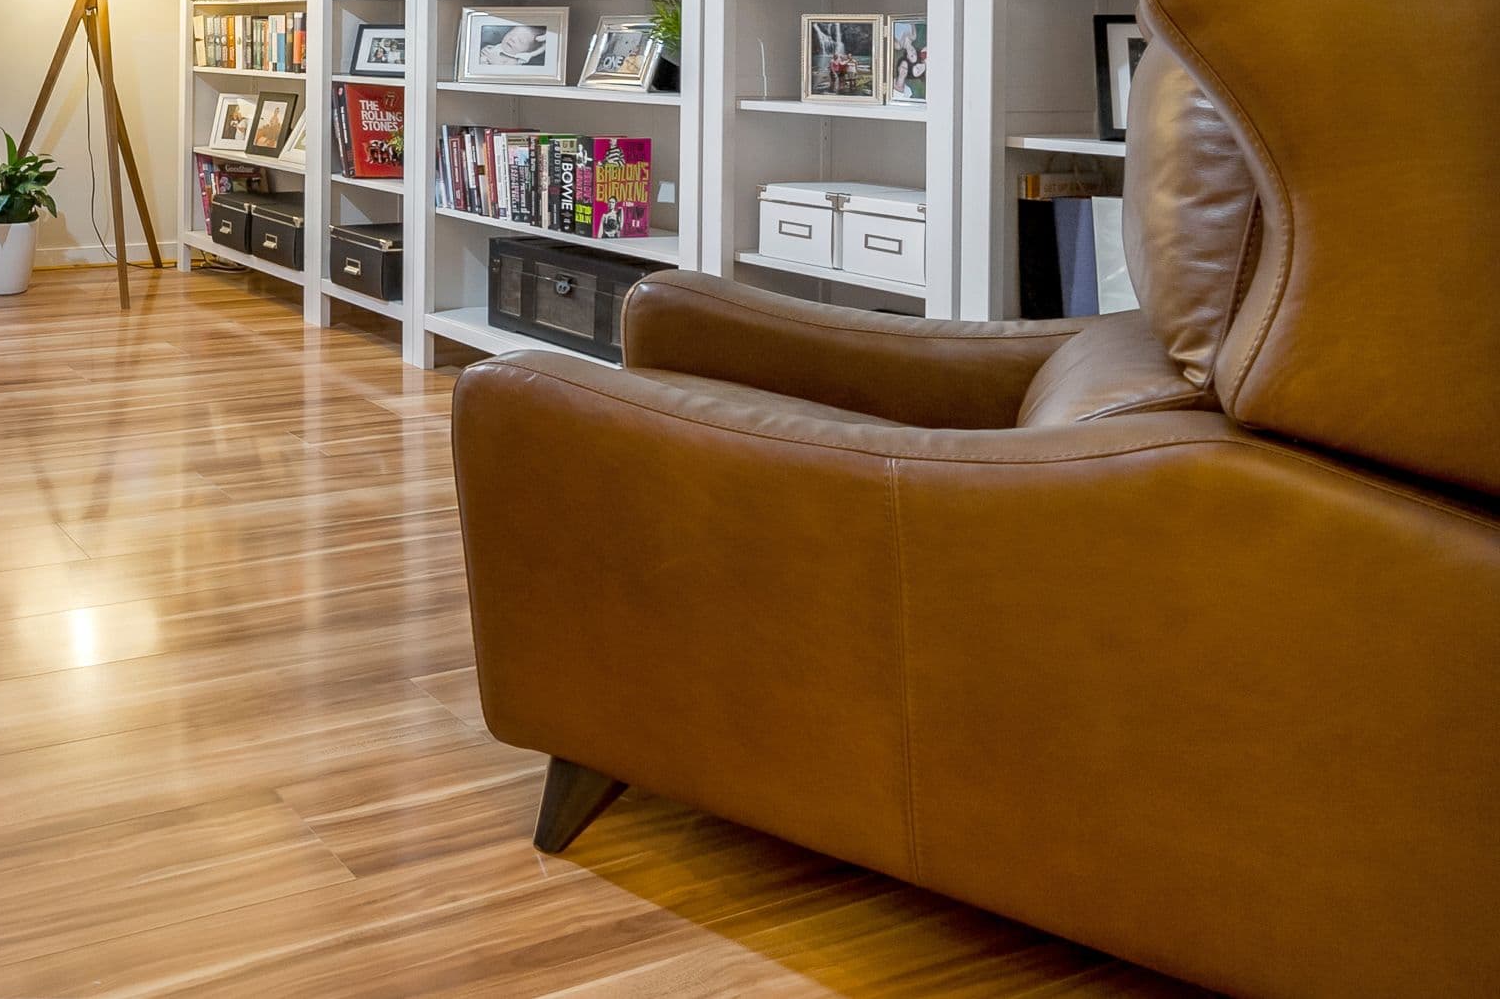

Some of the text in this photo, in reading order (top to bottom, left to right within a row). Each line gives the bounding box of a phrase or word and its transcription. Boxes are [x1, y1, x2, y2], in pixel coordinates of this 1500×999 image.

[359, 99, 380, 111] THE
[360, 110, 403, 122] ROLLING
[362, 120, 399, 132] STONES
[561, 162, 574, 211] BOWIE
[596, 181, 648, 203] BURNING
